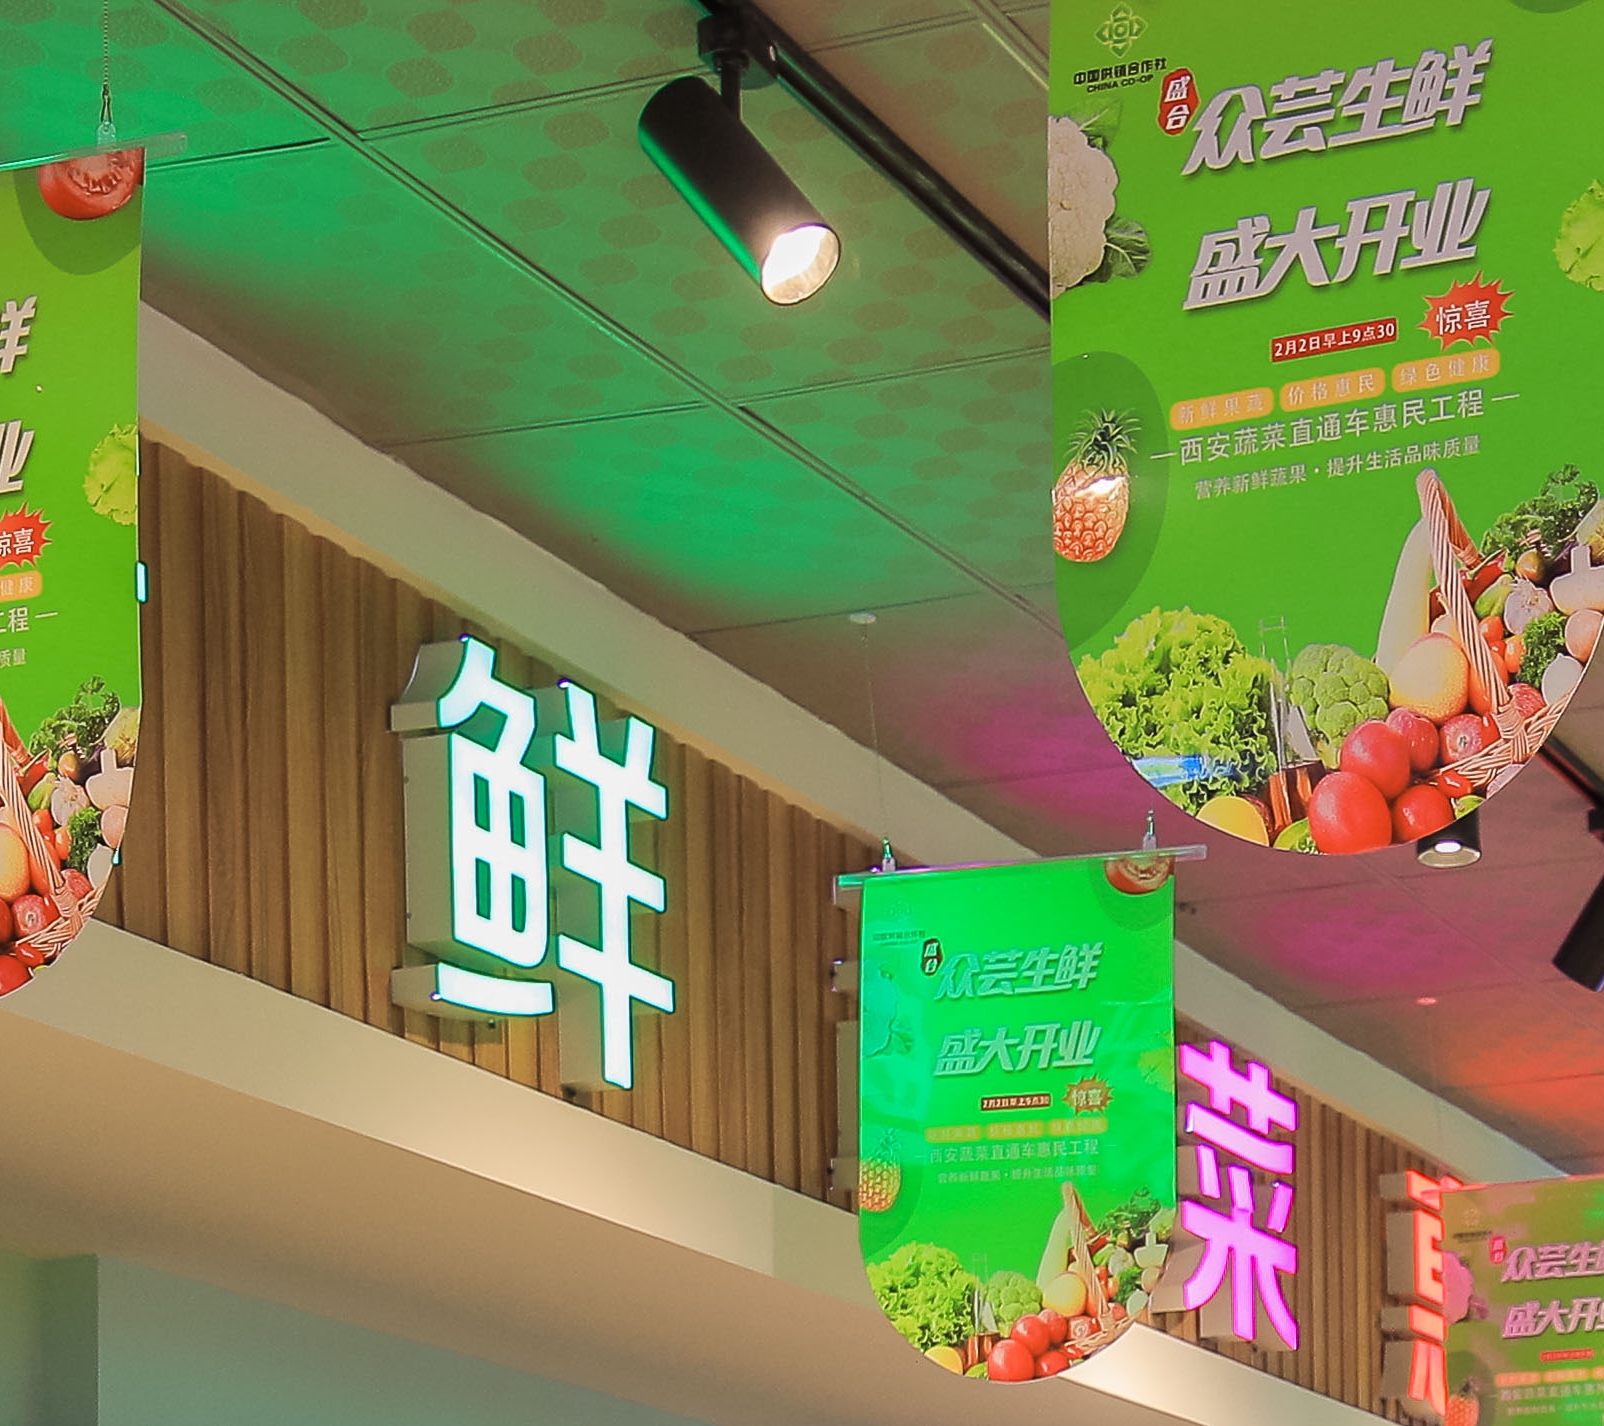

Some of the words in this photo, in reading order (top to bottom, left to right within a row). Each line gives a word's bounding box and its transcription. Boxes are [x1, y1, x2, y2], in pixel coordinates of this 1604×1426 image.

[1073, 57, 1166, 86] 中国供销合作社
[1087, 79, 1119, 93] CHINA
[1121, 74, 1154, 87] CO-OP
[1181, 38, 1493, 176] 众芸生鲜
[1183, 177, 1491, 310] 盛大开业
[1274, 322, 1395, 357] 2月2日早上9点30
[1436, 300, 1491, 334] 惊喜
[1179, 397, 1264, 423] 新鲜果蔬
[1288, 374, 1375, 404] 价格惠民
[1400, 354, 1490, 386] 绿色健康
[1180, 388, 1484, 465] 西安蔬菜直通车惠民工程
[438, 636, 676, 1090] 鲜
[1180, 1041, 1299, 1350] 菜
[934, 943, 1103, 1000] 众芸生鲜
[933, 1021, 1101, 1077] 盛大开业
